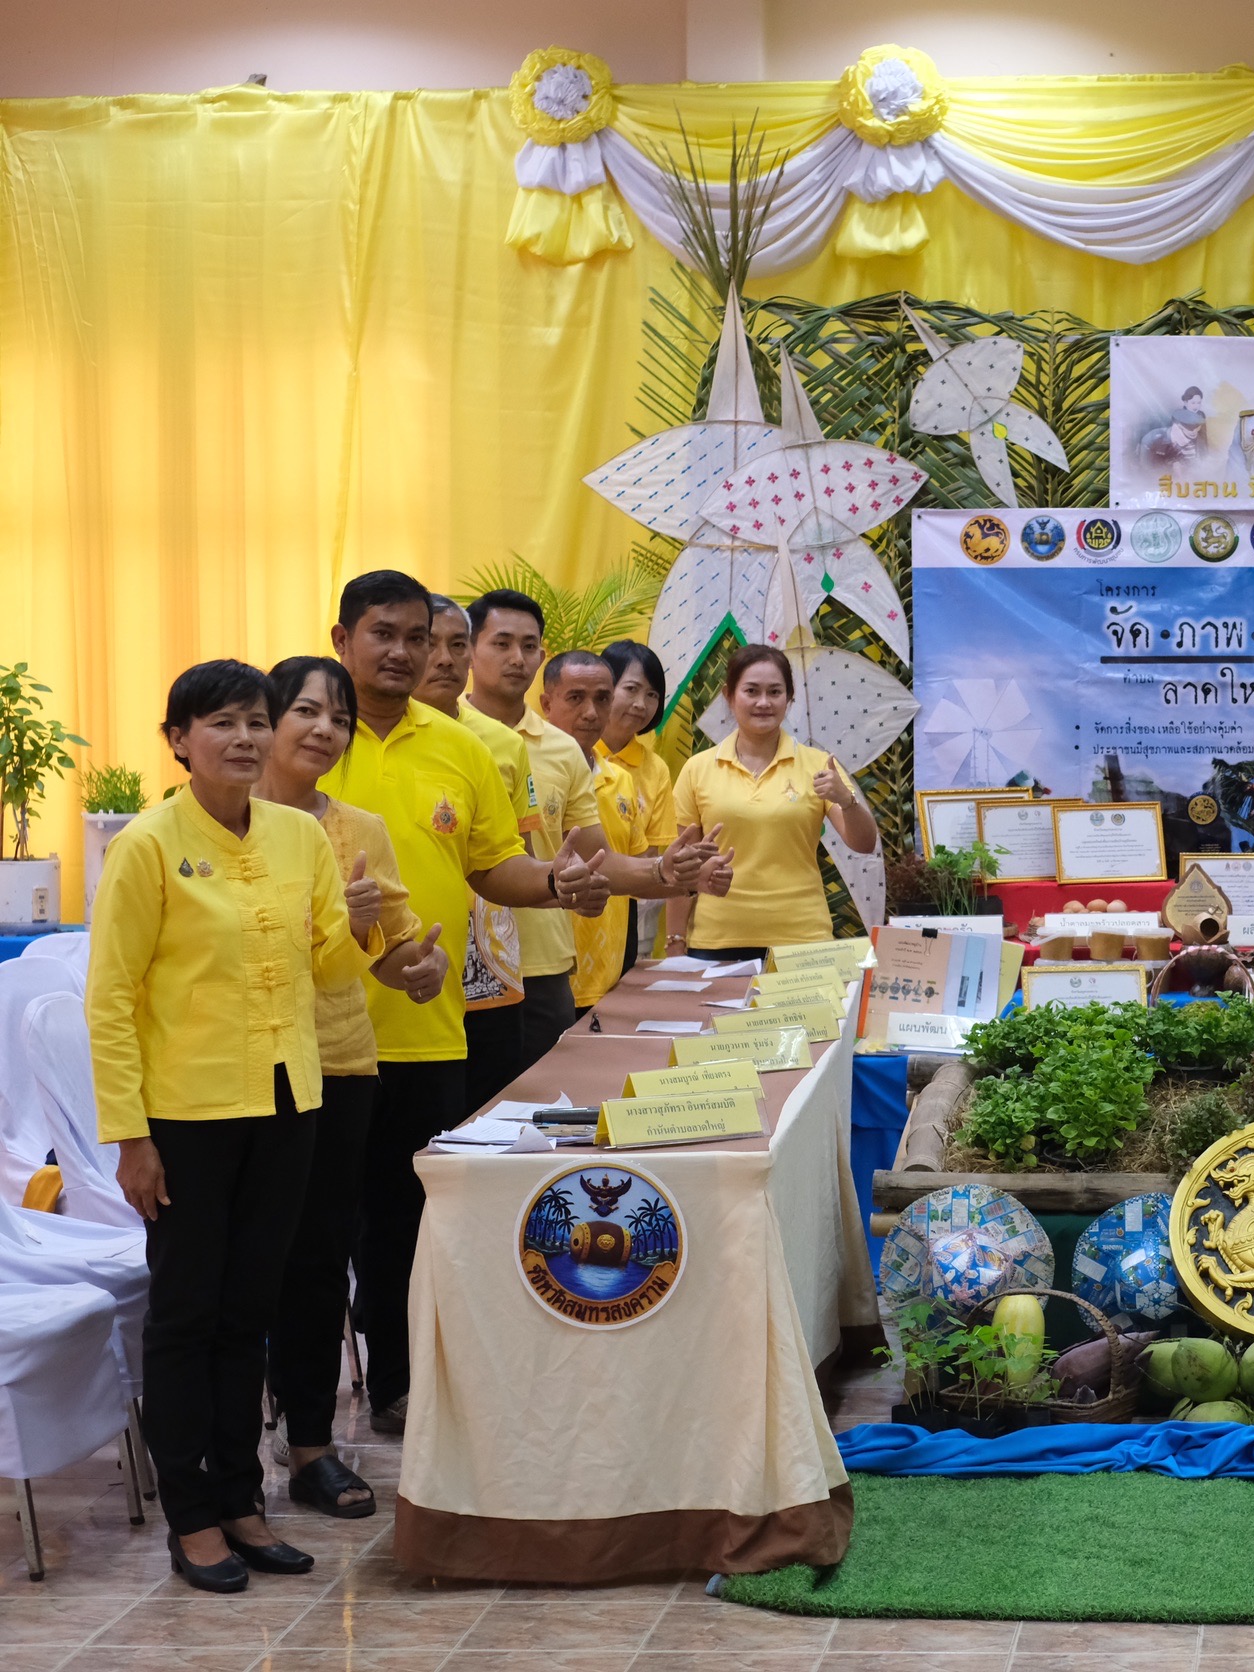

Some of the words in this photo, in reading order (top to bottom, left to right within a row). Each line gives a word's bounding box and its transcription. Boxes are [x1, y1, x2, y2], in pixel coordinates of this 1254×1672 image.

[1158, 474, 1238, 498] สืบสาน
[1096, 579, 1158, 598] โครงการ
[1106, 604, 1151, 650] จัด
[1176, 620, 1244, 649] ภาพ
[626, 1100, 686, 1117] นางสาวสุภัทรา
[687, 1097, 736, 1113] อินทร์สมบัติ
[646, 1118, 726, 1137] กำนันตำบลลาดใหญ่
